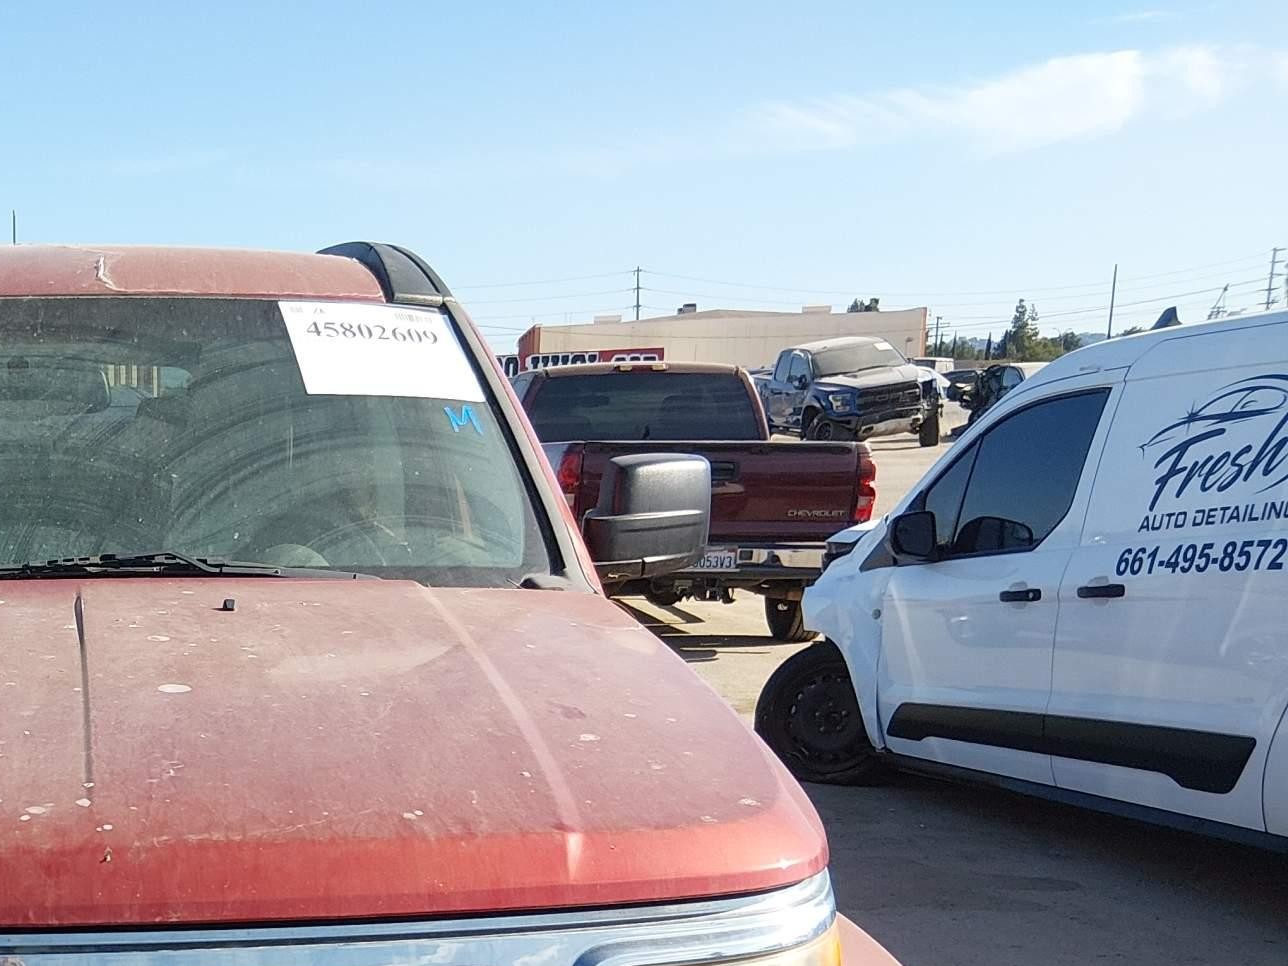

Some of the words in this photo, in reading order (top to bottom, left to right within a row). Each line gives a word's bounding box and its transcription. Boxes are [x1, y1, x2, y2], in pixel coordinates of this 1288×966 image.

[306, 321, 438, 344] 45802609
[1149, 412, 1288, 513] Fresh
[787, 509, 846, 517] CHEVROLET
[1138, 510, 1188, 533] AUTO
[1116, 538, 1288, 576] 661-495-8572
